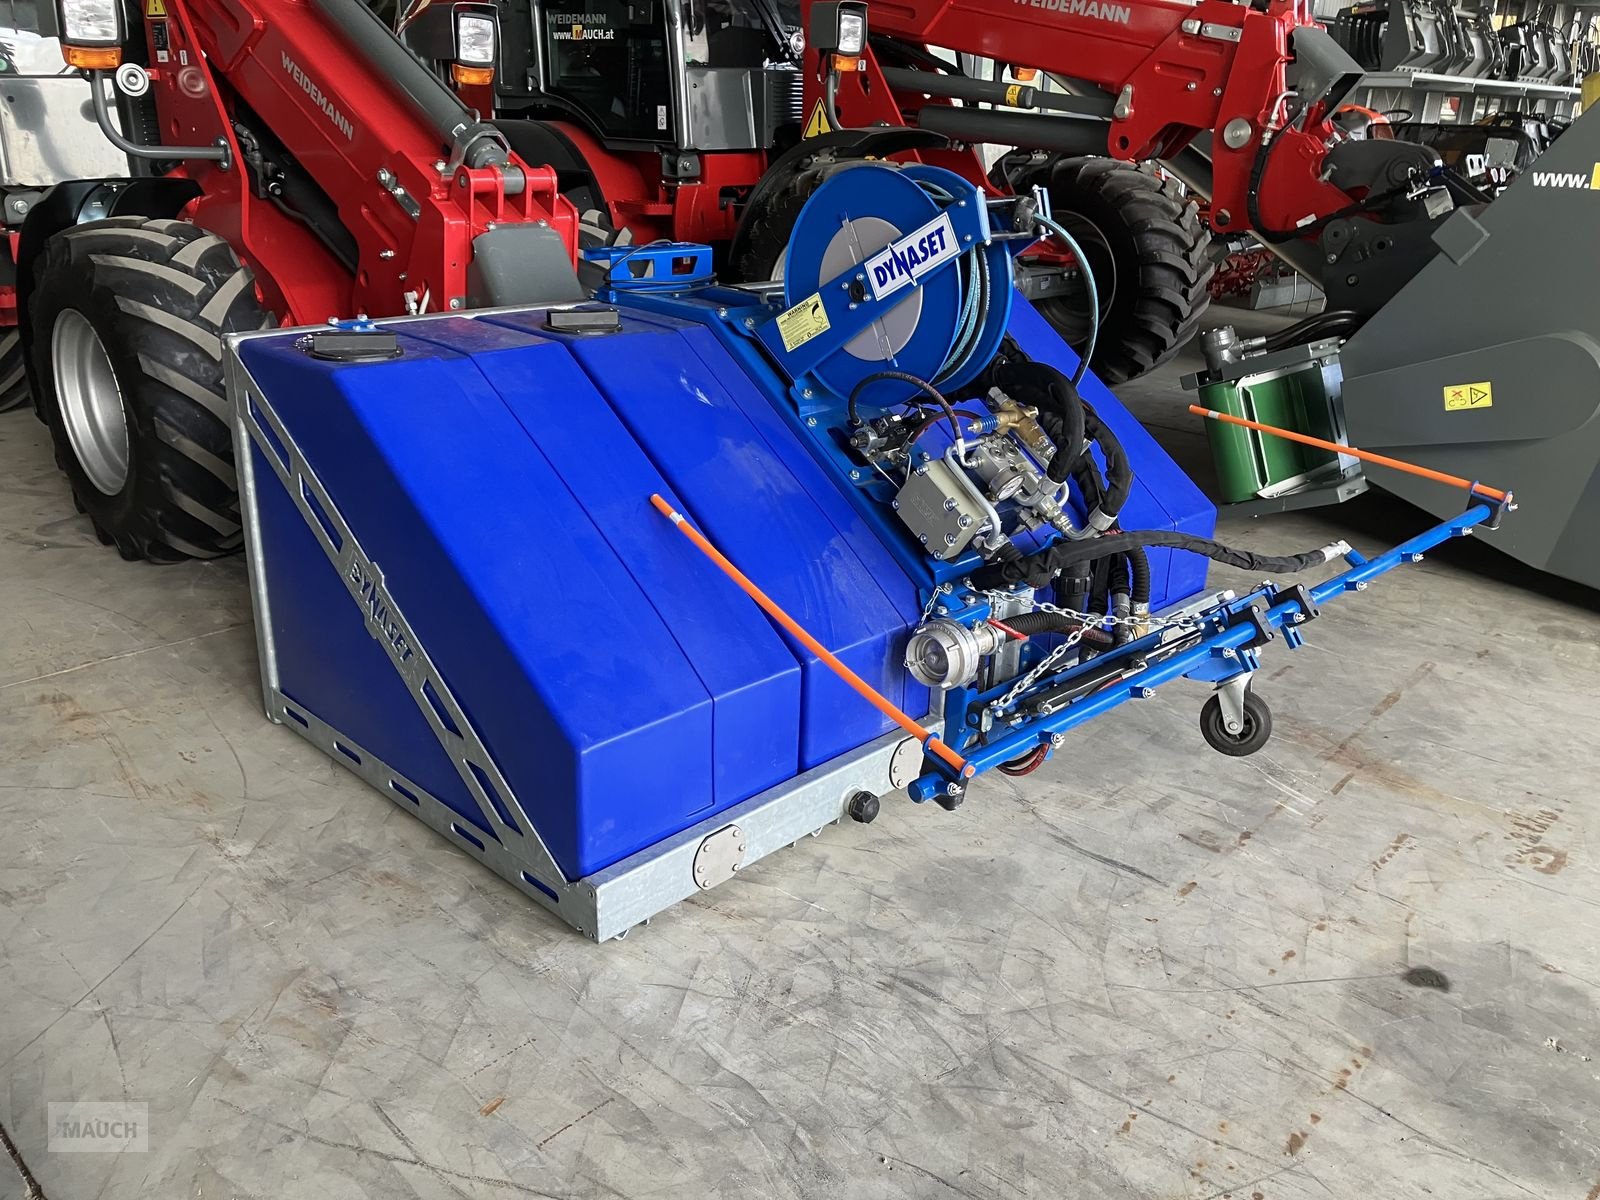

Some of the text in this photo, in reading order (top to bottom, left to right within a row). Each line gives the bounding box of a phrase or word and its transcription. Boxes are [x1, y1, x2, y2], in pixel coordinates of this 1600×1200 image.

[547, 13, 607, 25] WEIDEMANN
[1012, 0, 1131, 25] EIDEMANN
[281, 49, 354, 141] WEIDEMANN
[872, 225, 946, 289] DYNASET
[349, 560, 414, 662] DYNASET
